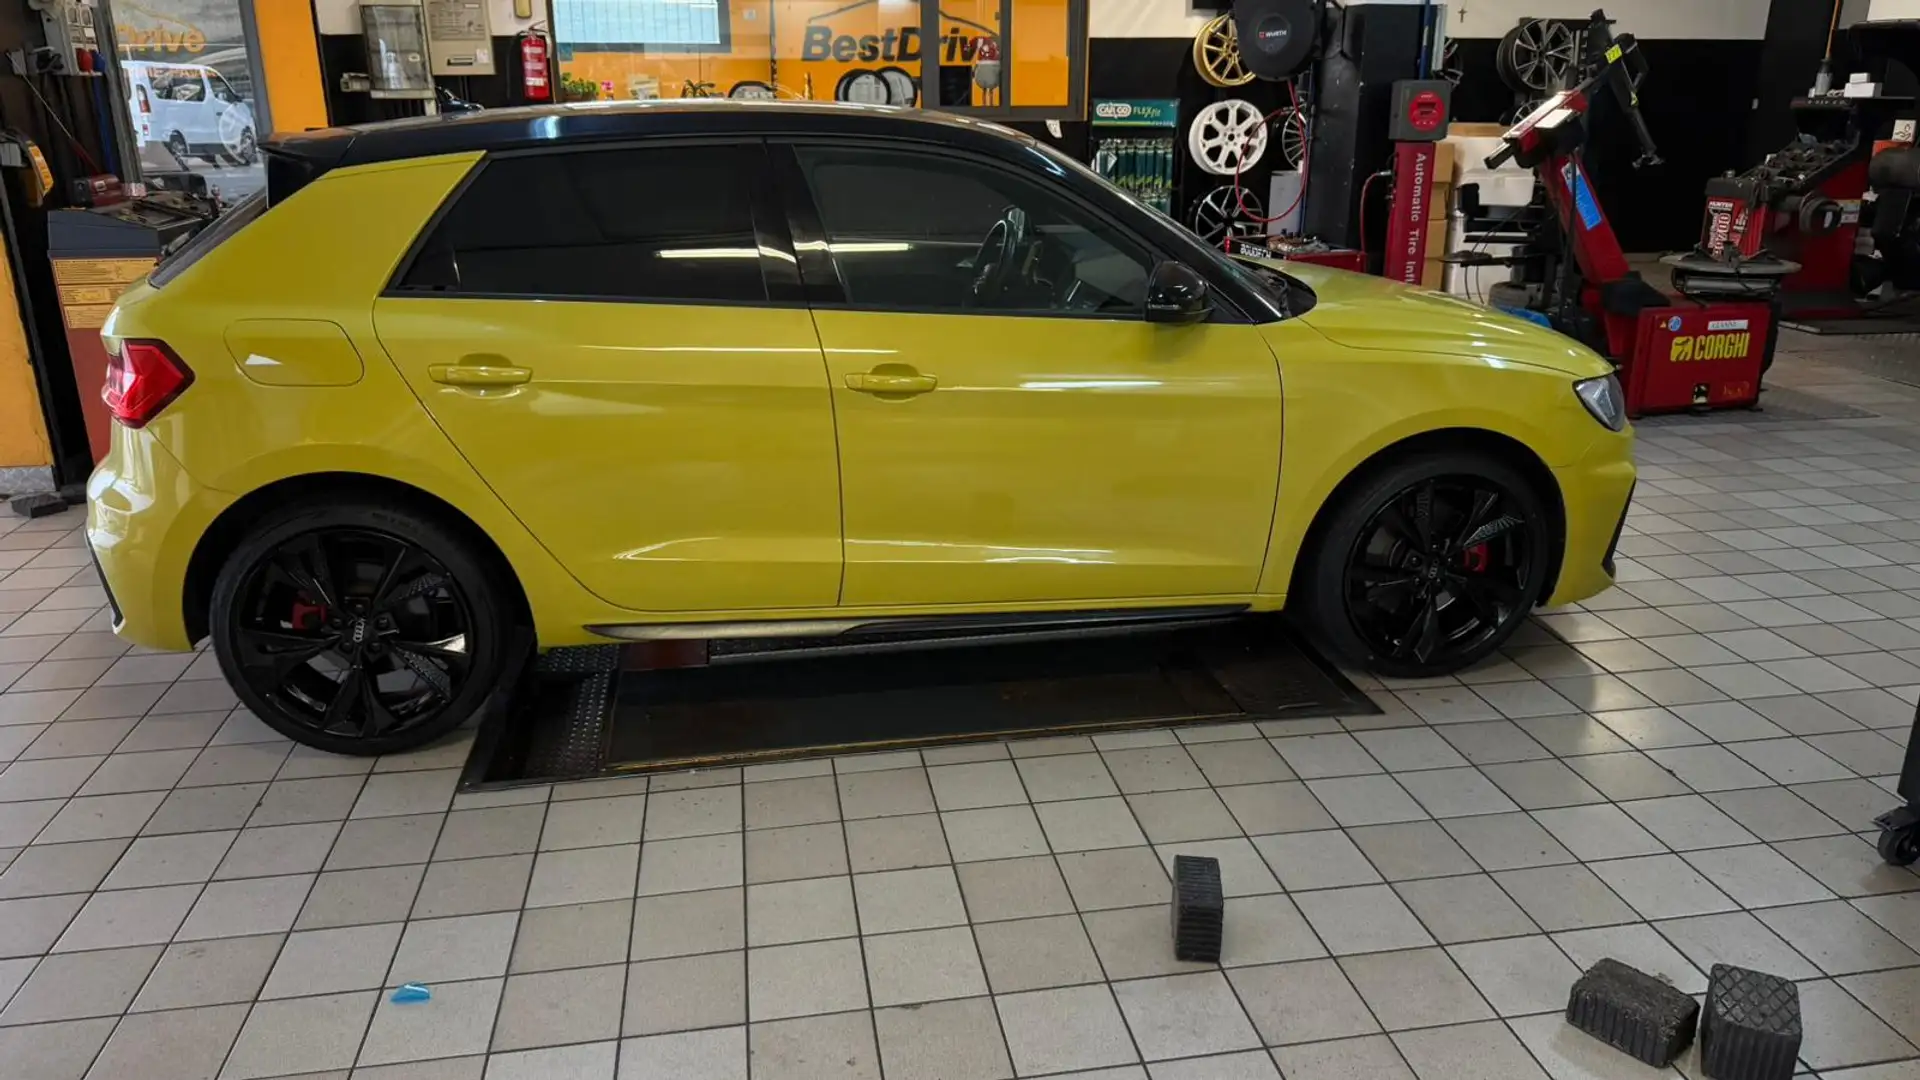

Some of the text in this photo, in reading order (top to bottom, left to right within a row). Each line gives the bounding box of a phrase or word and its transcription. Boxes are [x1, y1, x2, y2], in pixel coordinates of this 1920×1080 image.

[1404, 152, 1427, 282] Automatic Tire Infl
[1693, 332, 1750, 360] CORGHI
